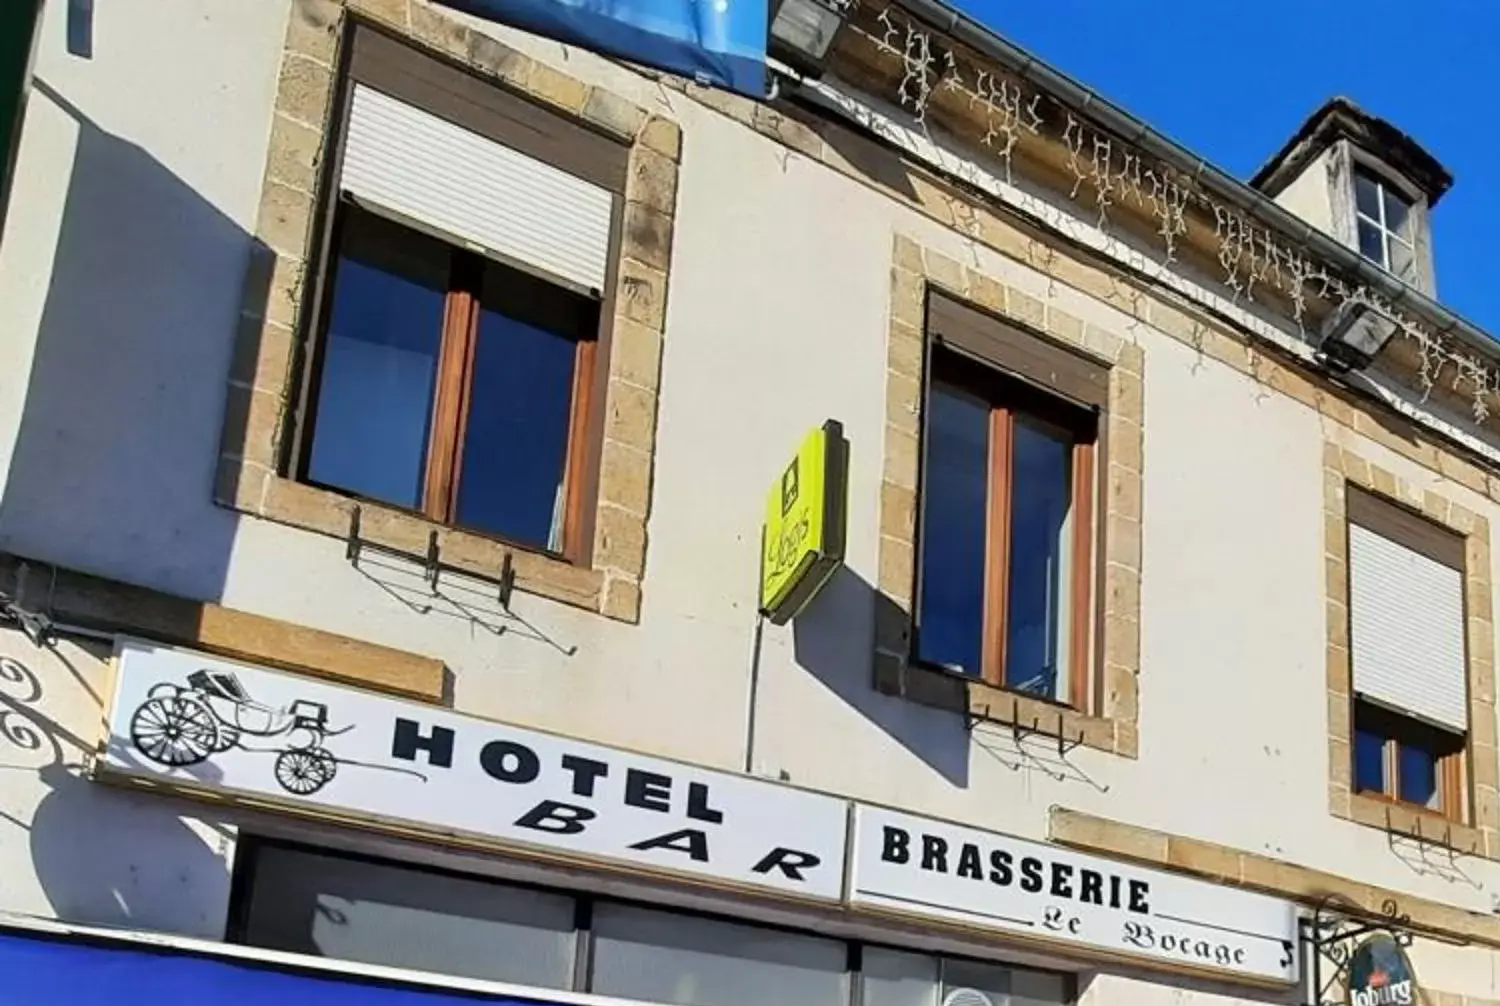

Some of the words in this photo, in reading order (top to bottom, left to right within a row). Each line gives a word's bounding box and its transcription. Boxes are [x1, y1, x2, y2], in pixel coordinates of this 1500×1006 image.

[392, 718, 723, 824] HOTEL
[513, 799, 821, 881] BAR
[882, 826, 1150, 914] BRASSERIE
[1042, 905, 1081, 934] Le
[1121, 920, 1248, 965] Bocage
